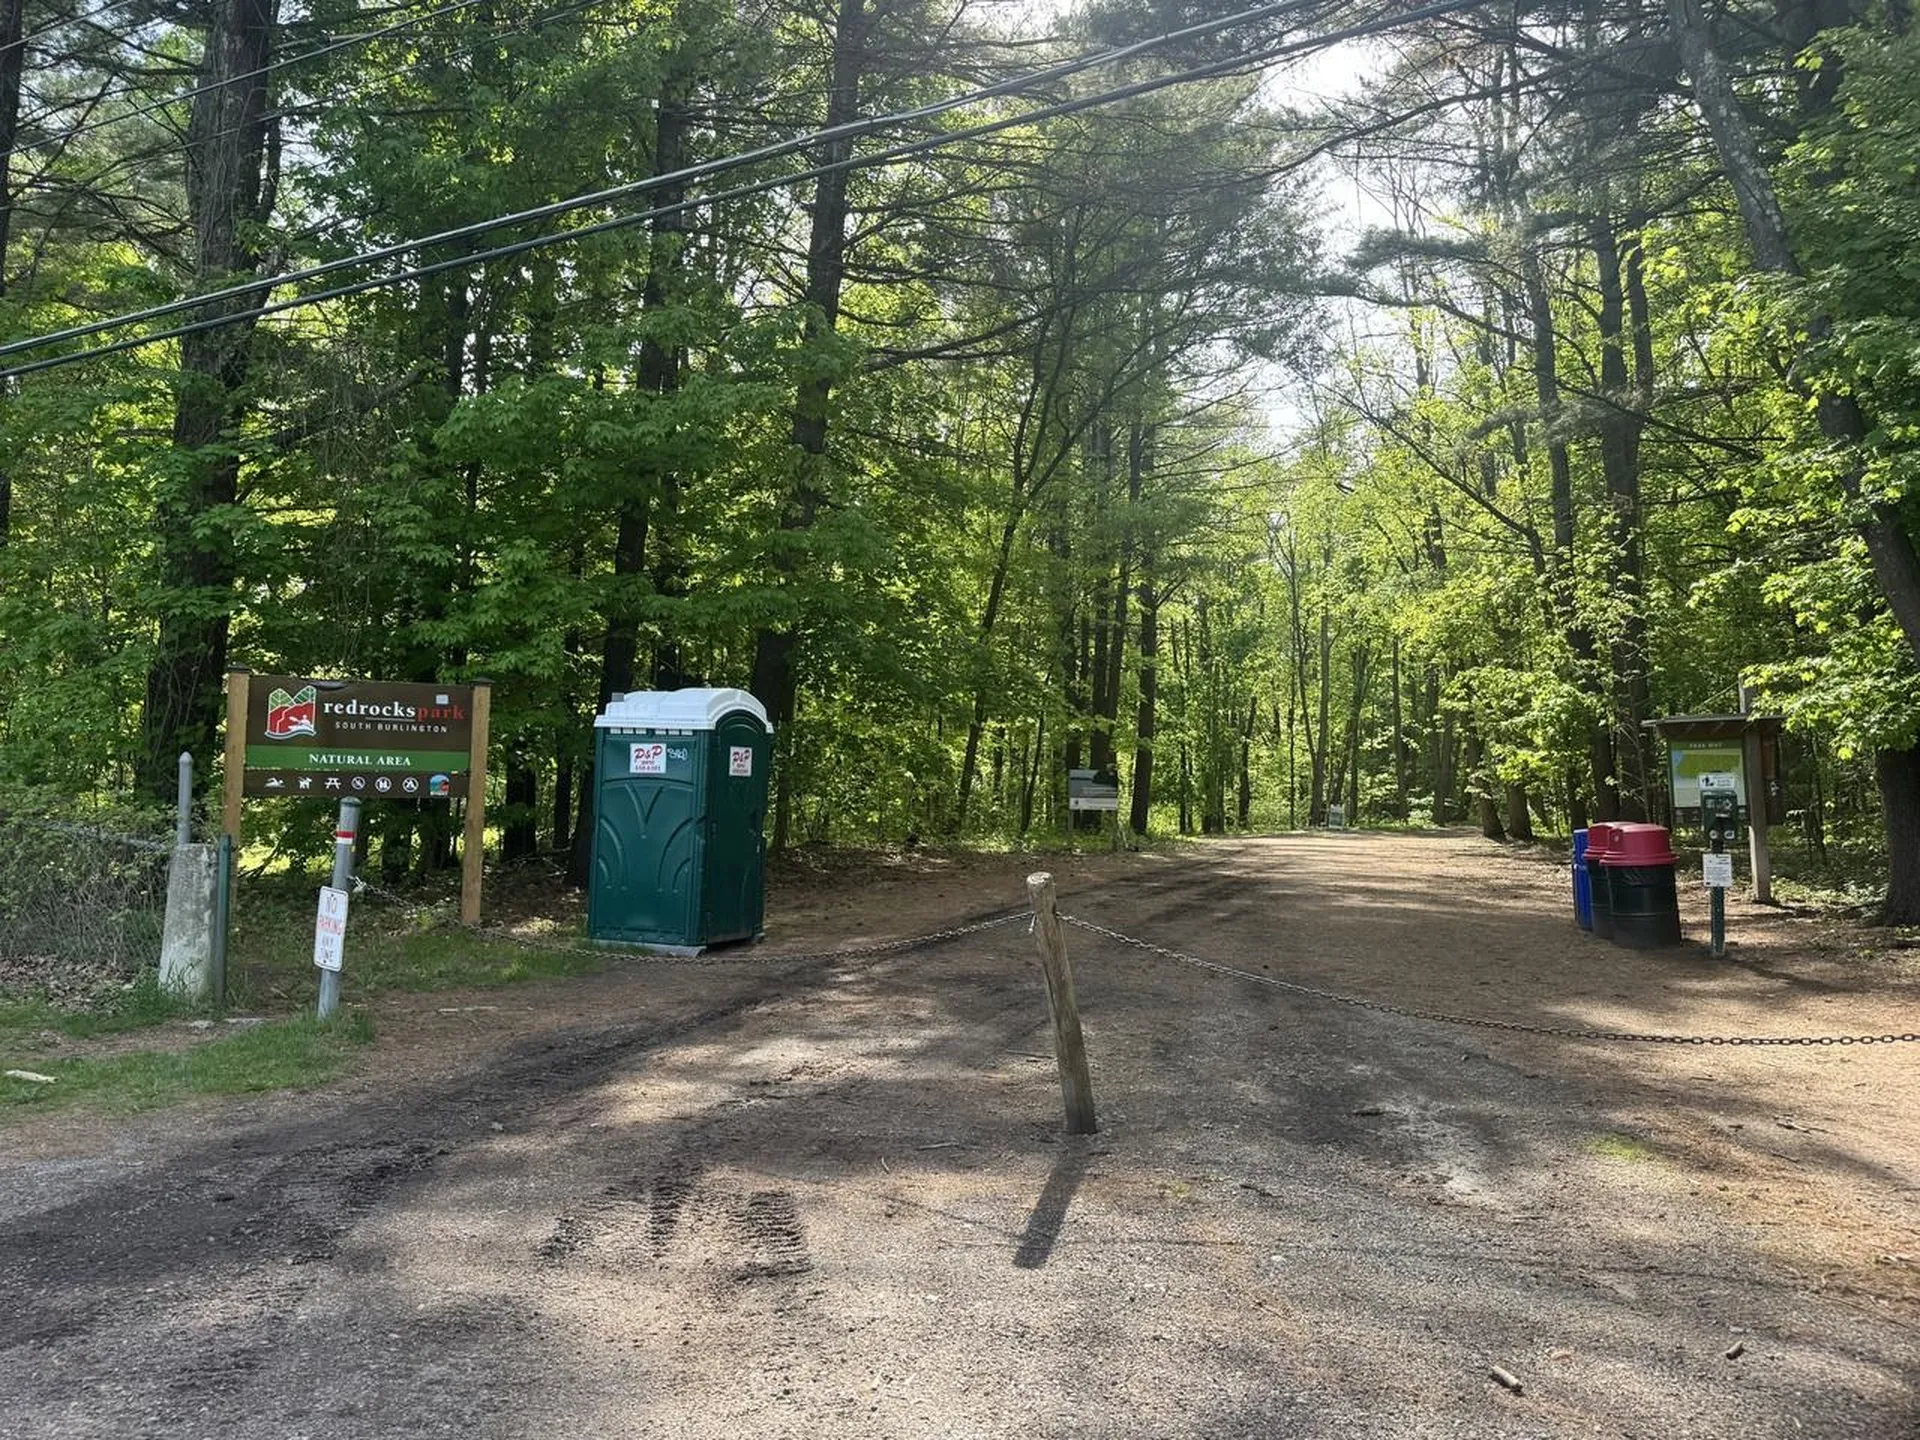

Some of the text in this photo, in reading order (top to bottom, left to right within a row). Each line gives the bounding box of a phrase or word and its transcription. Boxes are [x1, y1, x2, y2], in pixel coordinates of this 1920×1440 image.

[335, 721, 447, 733] SOUTH BURLINGTON
[308, 753, 411, 766] NATURAL AREA
[324, 896, 337, 914] NO
